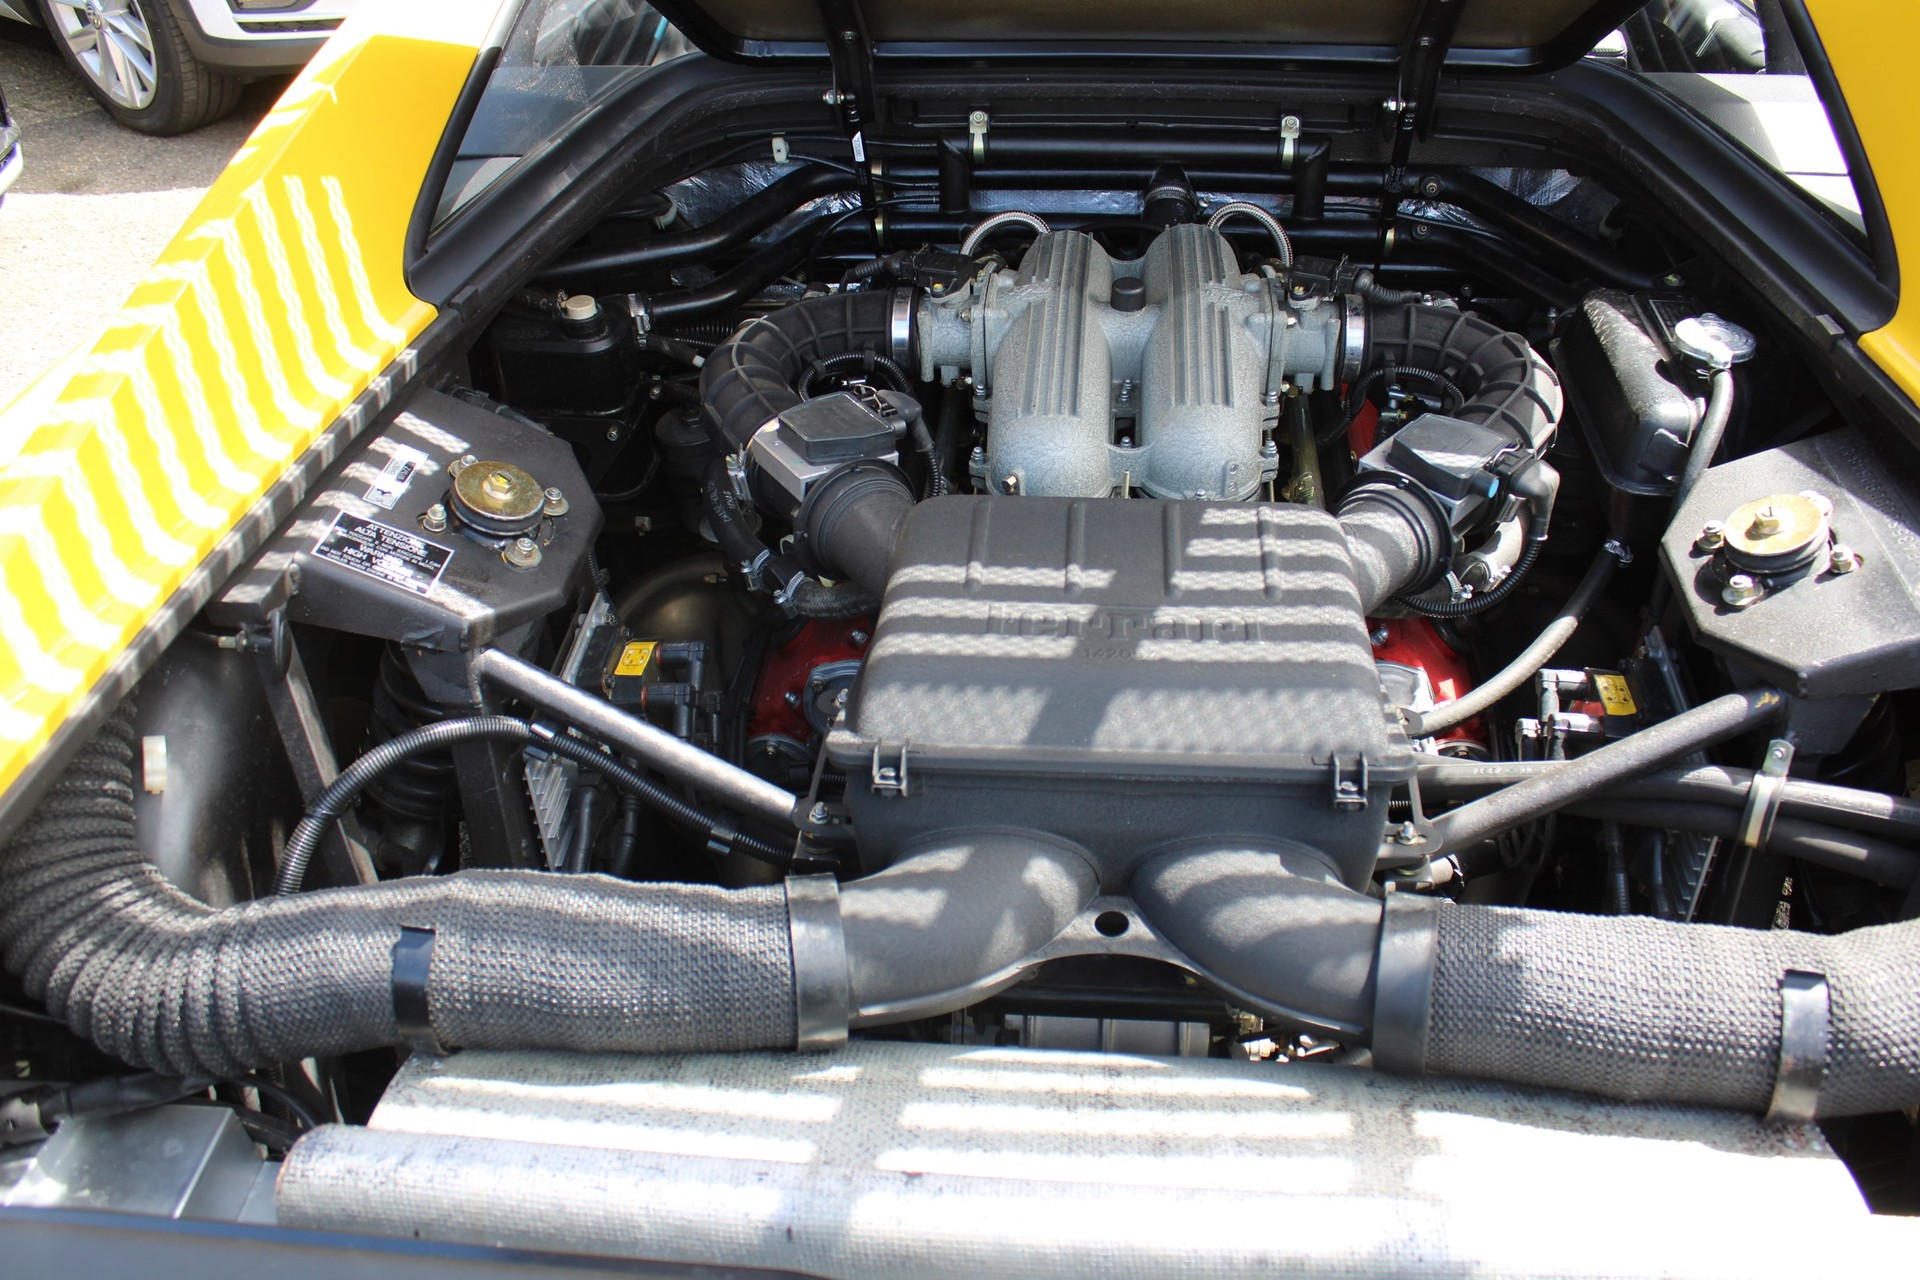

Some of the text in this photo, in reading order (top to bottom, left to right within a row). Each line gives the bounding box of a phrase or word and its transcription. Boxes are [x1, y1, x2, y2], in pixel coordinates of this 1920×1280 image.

[353, 526, 428, 557] ALTA TENSIONE
[365, 523, 426, 549] ATTENZIONE
[342, 546, 368, 559] HIGH
[357, 544, 404, 565] WARN
[983, 603, 1262, 645] Ferrari
